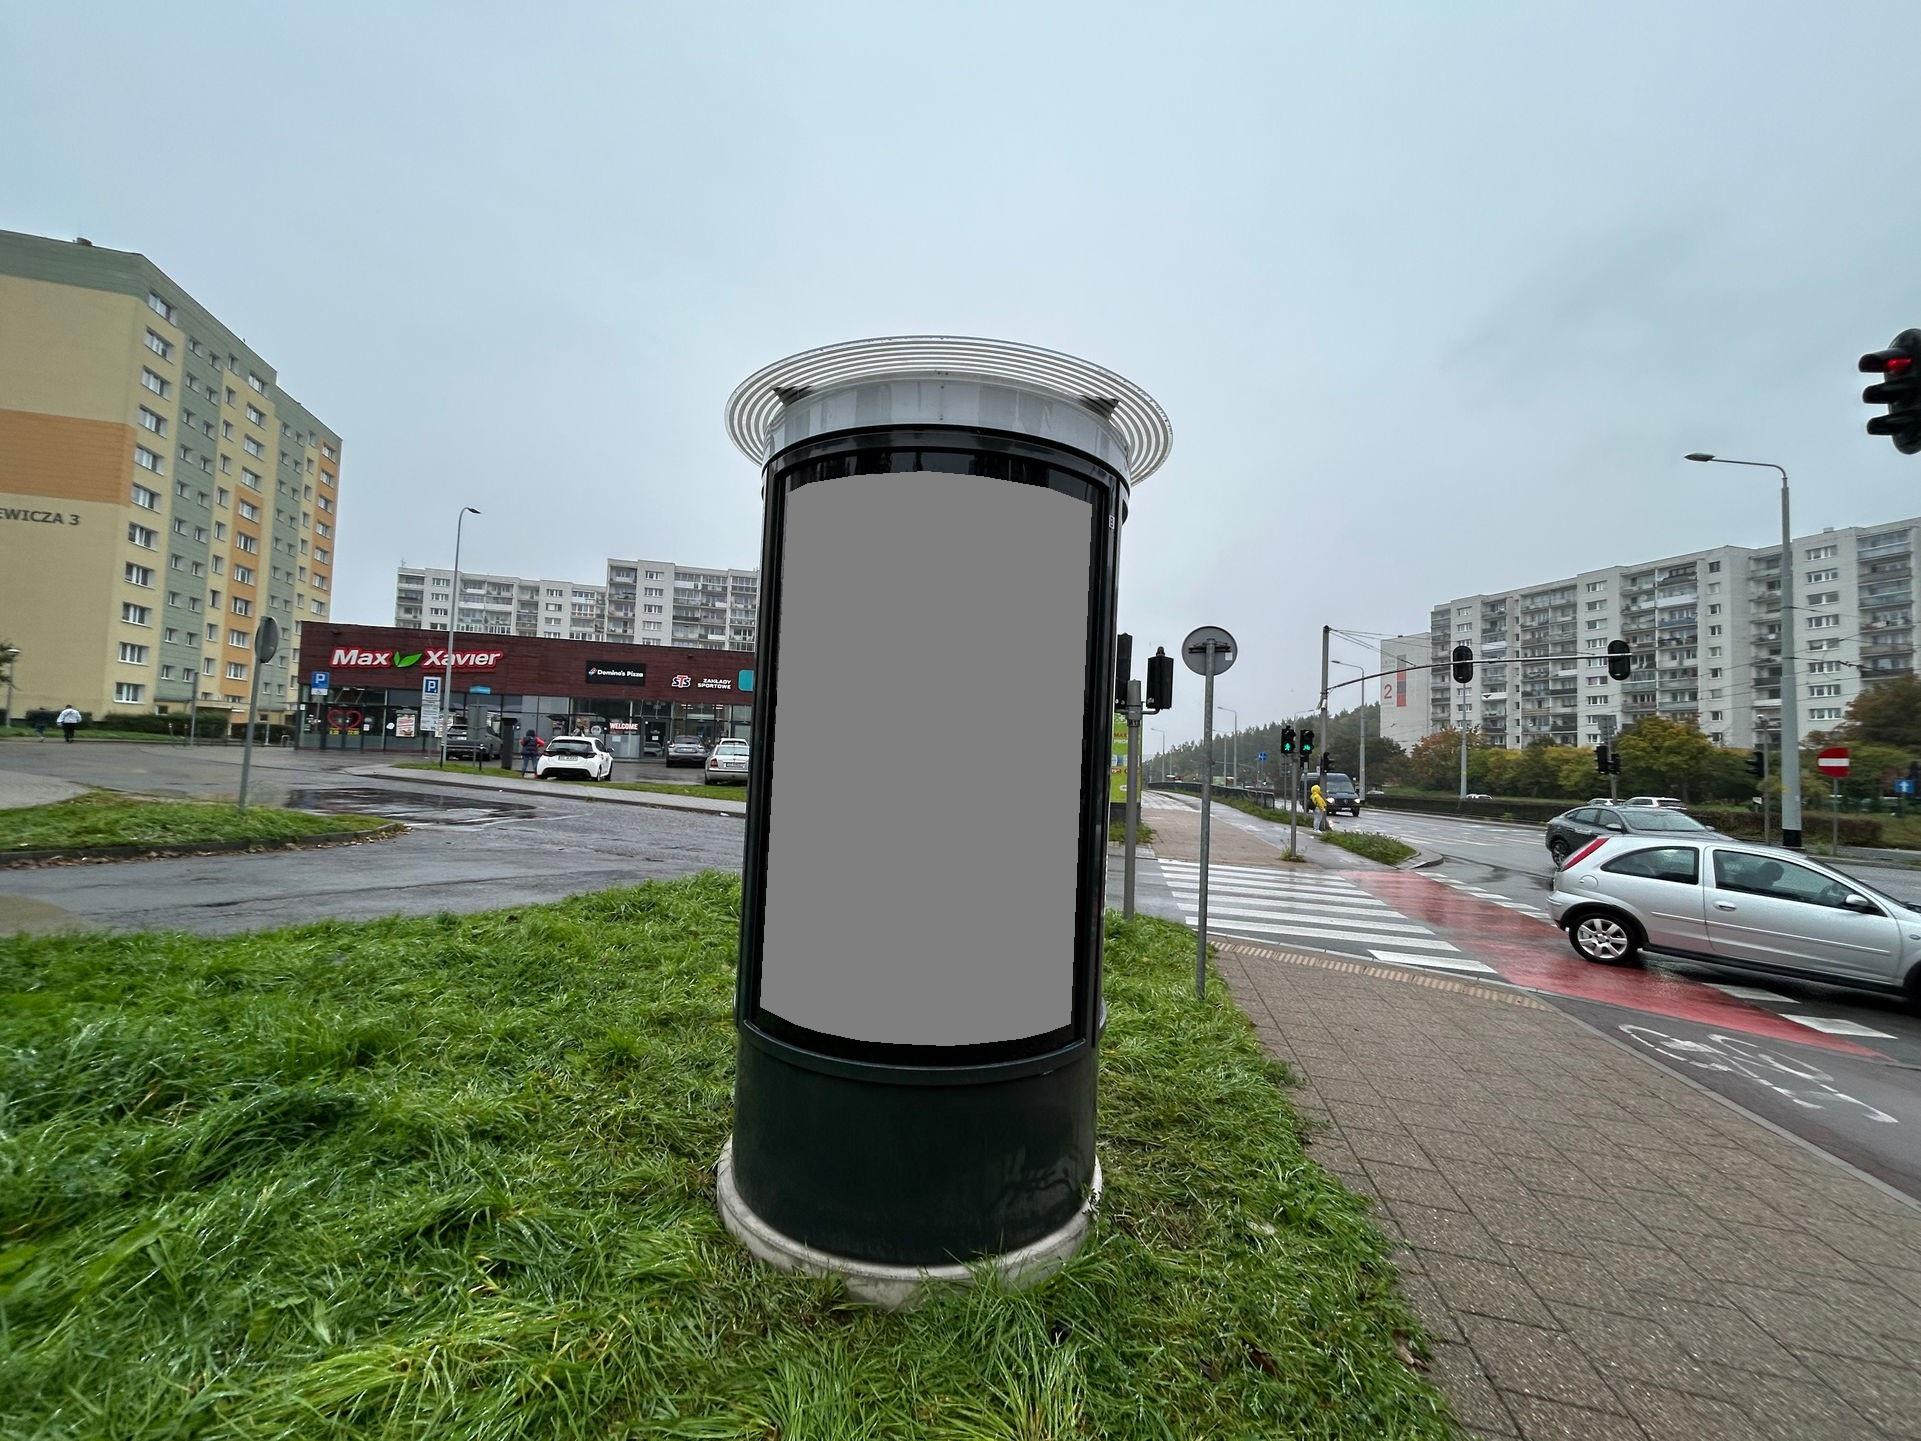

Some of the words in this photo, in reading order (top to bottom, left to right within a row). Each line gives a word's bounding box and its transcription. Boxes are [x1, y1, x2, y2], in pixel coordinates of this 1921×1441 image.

[69, 514, 80, 525] 3
[332, 649, 390, 666] Max
[424, 650, 501, 666] Xavier
[315, 673, 326, 684] P
[597, 669, 626, 677] Domino's
[627, 670, 644, 678] Pizza
[671, 674, 692, 688] STS
[697, 682, 732, 690] SPORTOWE
[1383, 683, 1393, 700] 2
[609, 722, 639, 730] WELCOME
